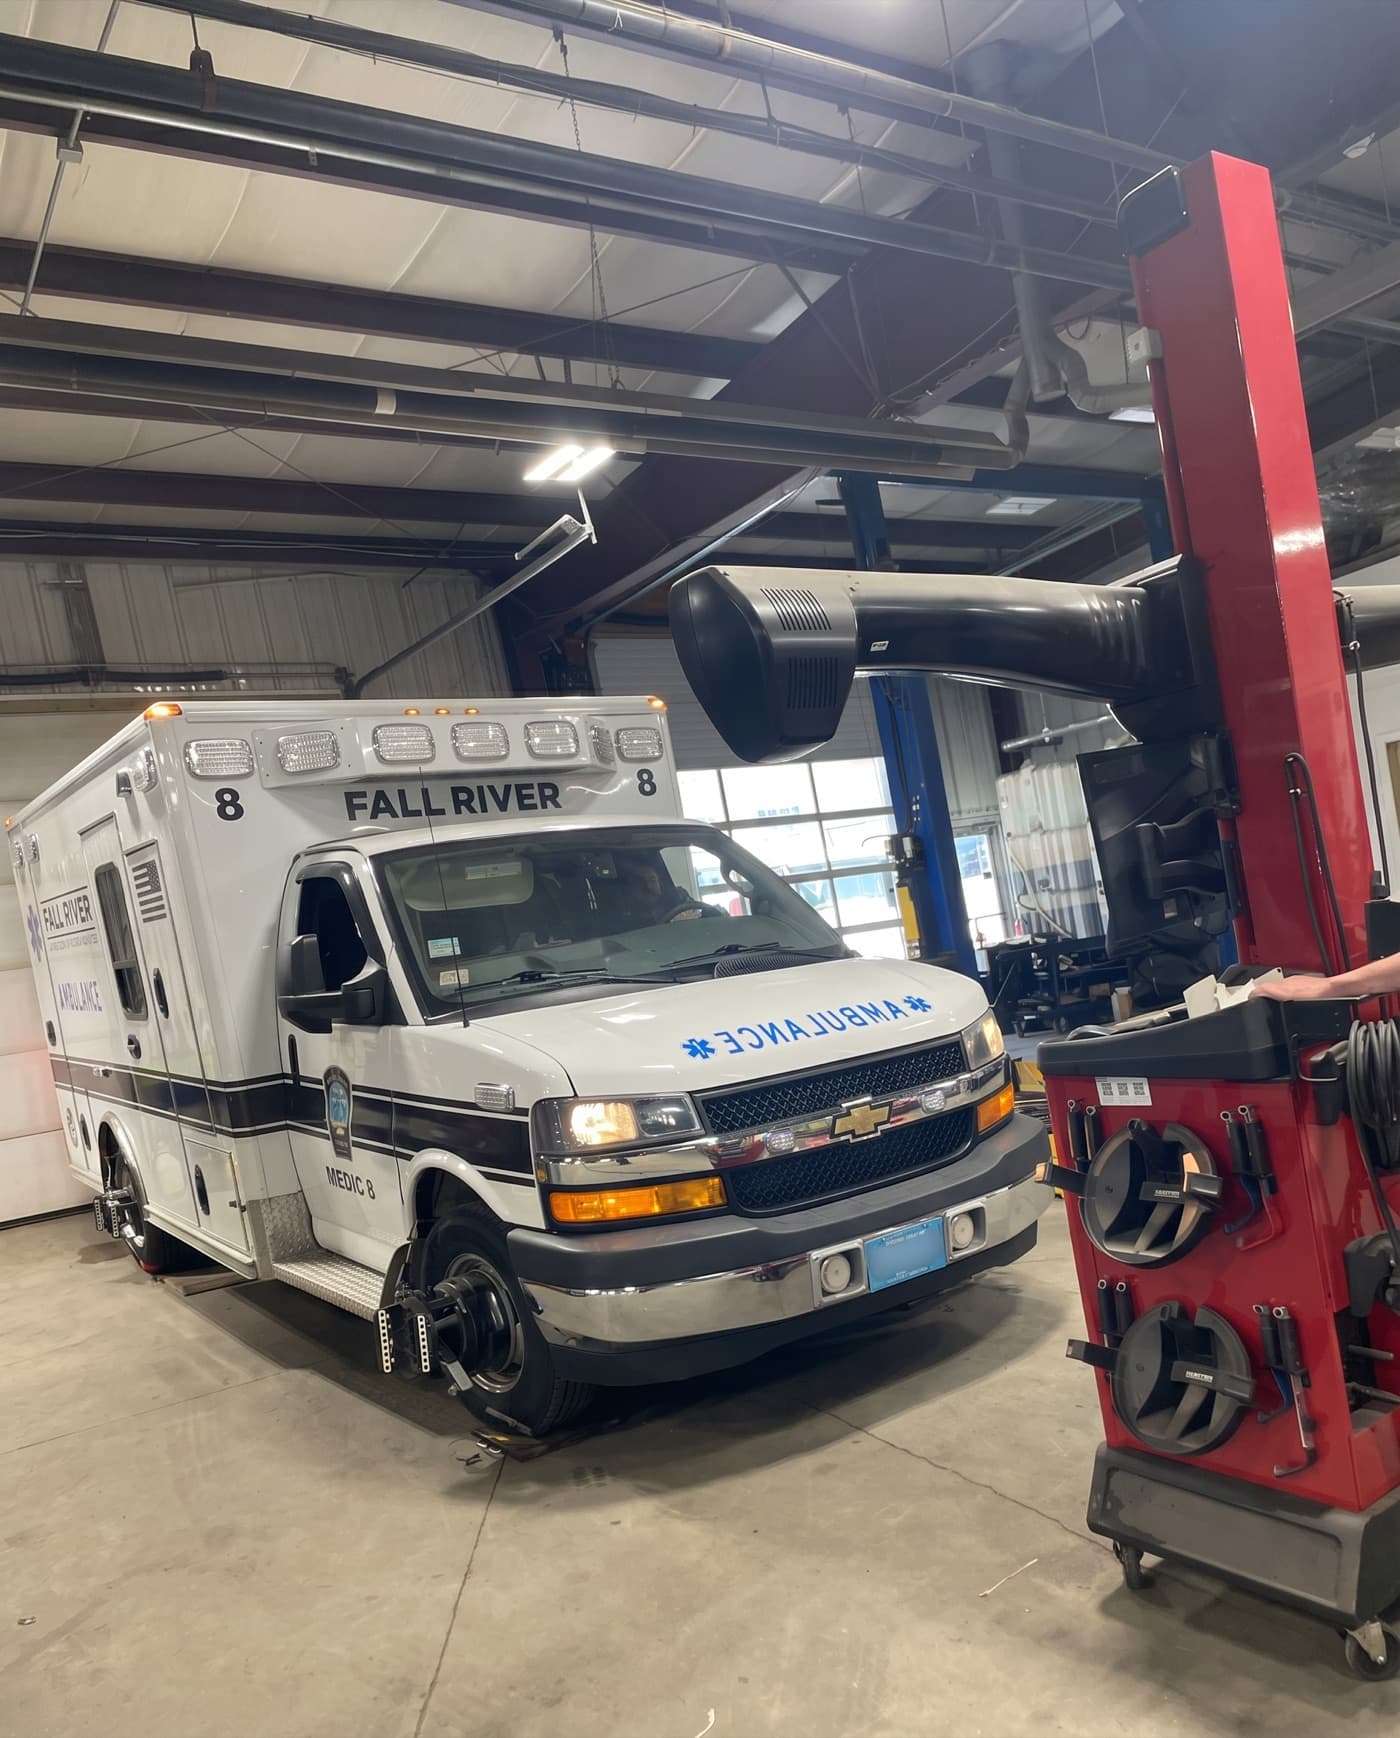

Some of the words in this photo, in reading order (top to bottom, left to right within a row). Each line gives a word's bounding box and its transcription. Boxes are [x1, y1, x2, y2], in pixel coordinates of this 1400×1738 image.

[636, 768, 658, 797] 8
[214, 787, 245, 822] 8
[344, 787, 446, 821] FALL
[450, 782, 562, 815] RIVER
[43, 903, 64, 932] FALL
[63, 895, 93, 927] RIVER
[58, 981, 102, 1012] AMBULANCE
[325, 1165, 365, 1197] MEDIC
[366, 1179, 376, 1200] 8
